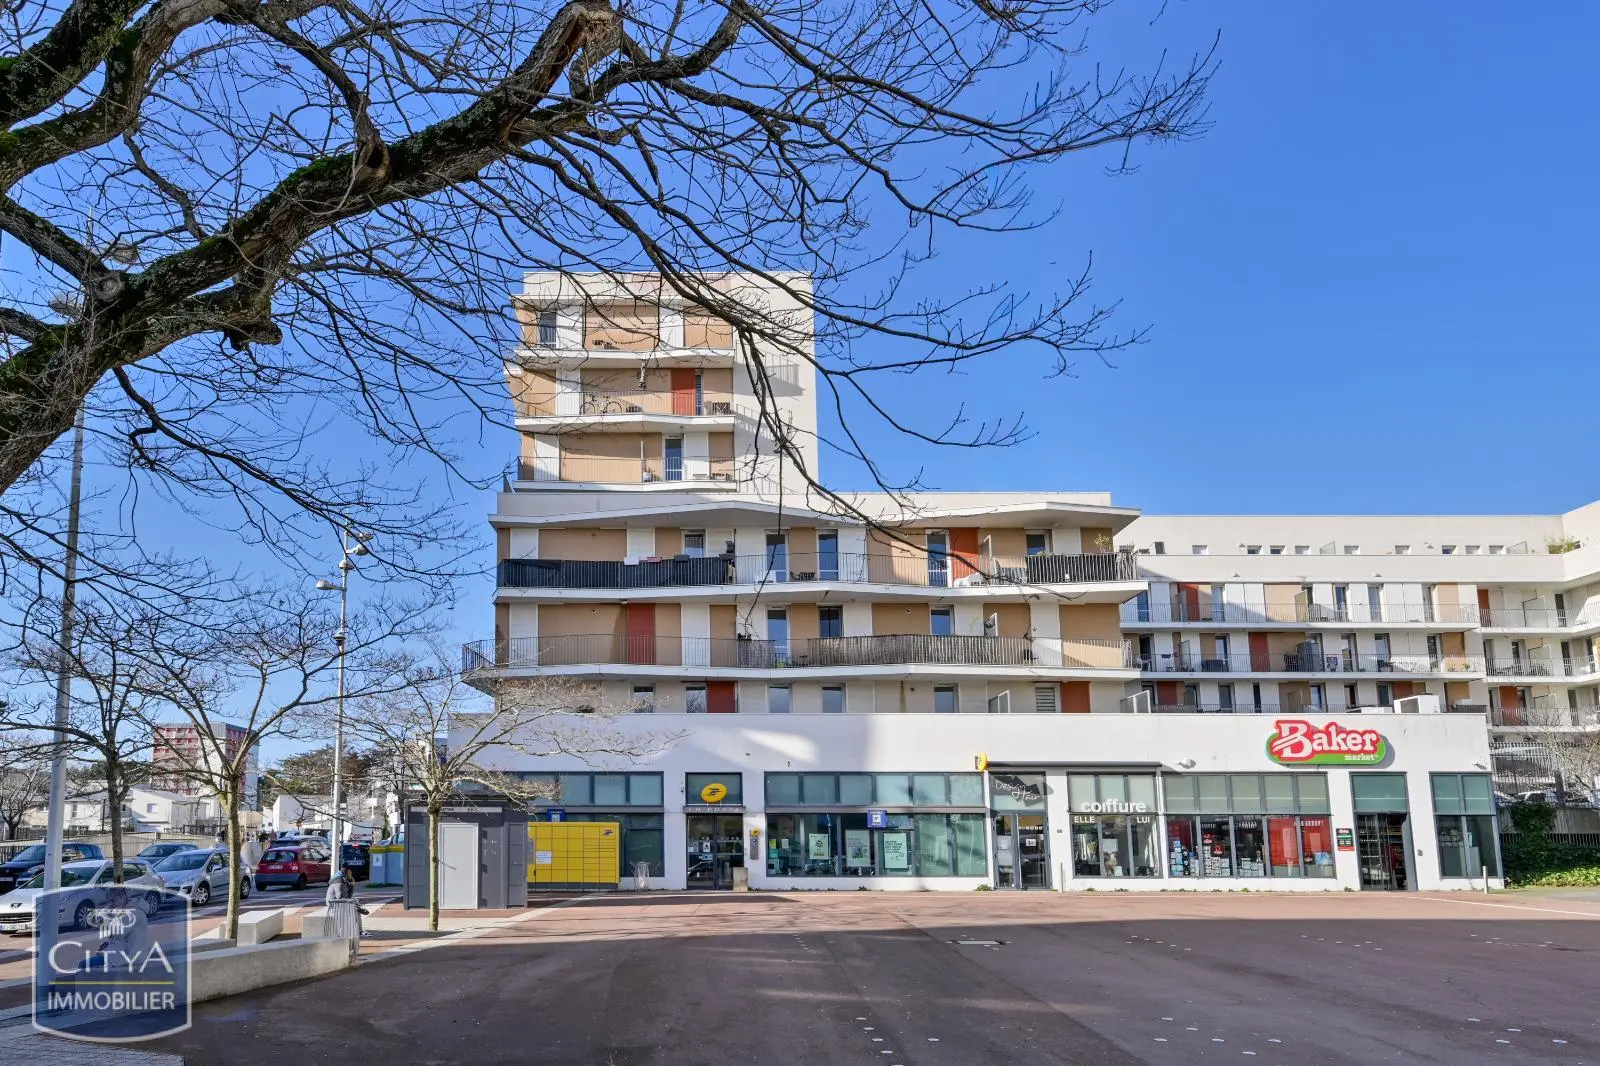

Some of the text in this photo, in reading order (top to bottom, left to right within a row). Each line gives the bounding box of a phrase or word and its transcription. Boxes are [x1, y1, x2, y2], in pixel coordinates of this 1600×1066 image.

[1272, 723, 1377, 758] Baker
[1344, 753, 1375, 761] market
[995, 780, 1026, 799] Design
[1012, 786, 1041, 801] Hair
[1080, 798, 1147, 813] coiffure
[1074, 816, 1095, 824] ELLE
[1136, 816, 1150, 824] LUI
